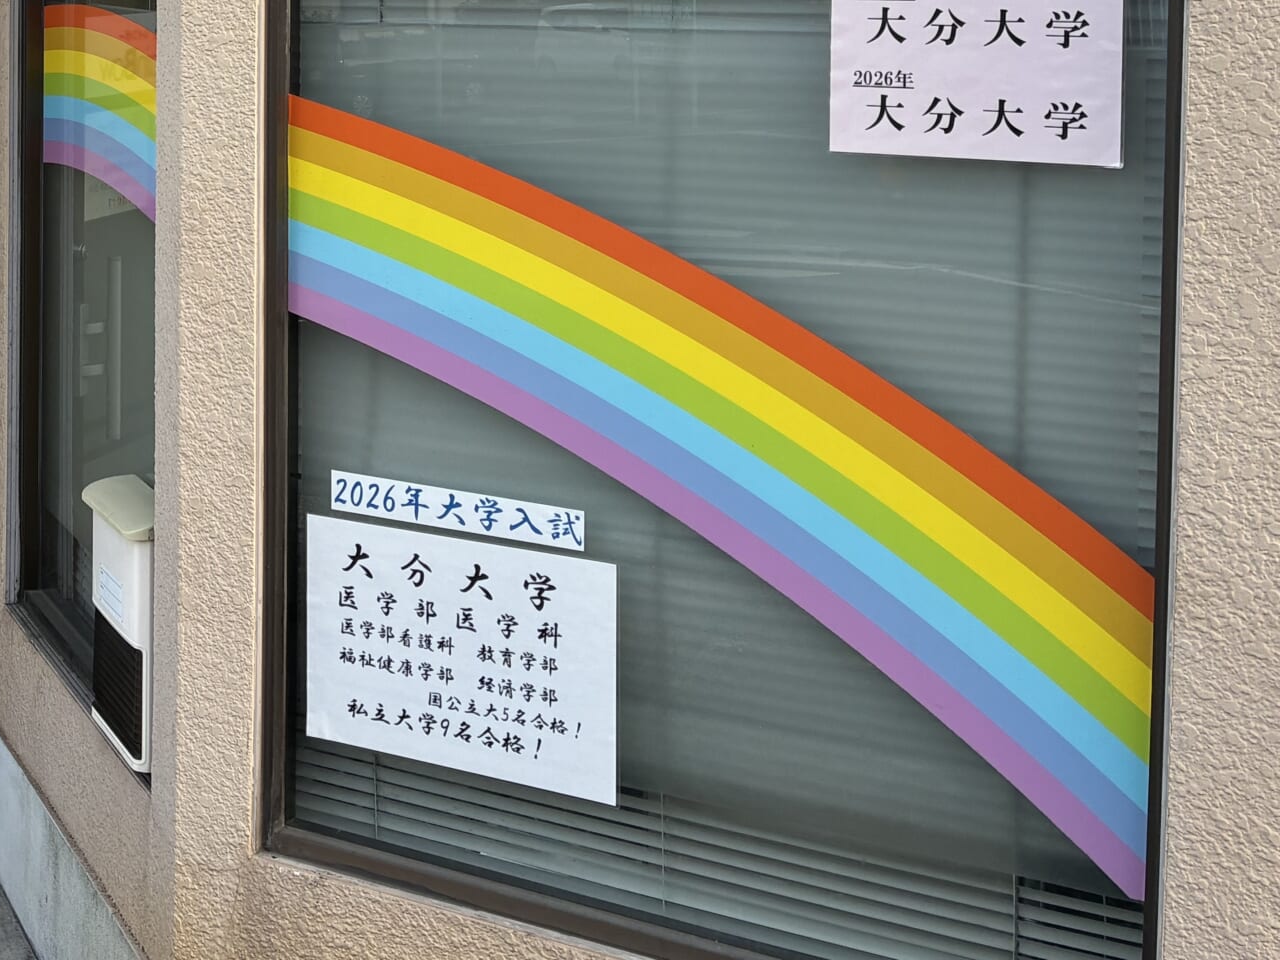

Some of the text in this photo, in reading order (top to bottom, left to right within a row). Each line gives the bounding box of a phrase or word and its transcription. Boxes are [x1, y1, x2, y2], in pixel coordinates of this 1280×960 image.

[866, 7, 1090, 49] 大分大学
[853, 70, 914, 88] 2026年
[864, 94, 1089, 140] 大分大学
[333, 478, 582, 546] 2026年大学入試
[341, 543, 557, 611] 大分大学
[338, 586, 562, 649] 医学部医学科
[340, 618, 558, 676] 医学部看護科 教育学部
[339, 646, 558, 707] 福祉健康学部 経済学部
[347, 698, 542, 760] 私立大学9名合格!
[428, 691, 582, 740] 国公立大5名合格!
